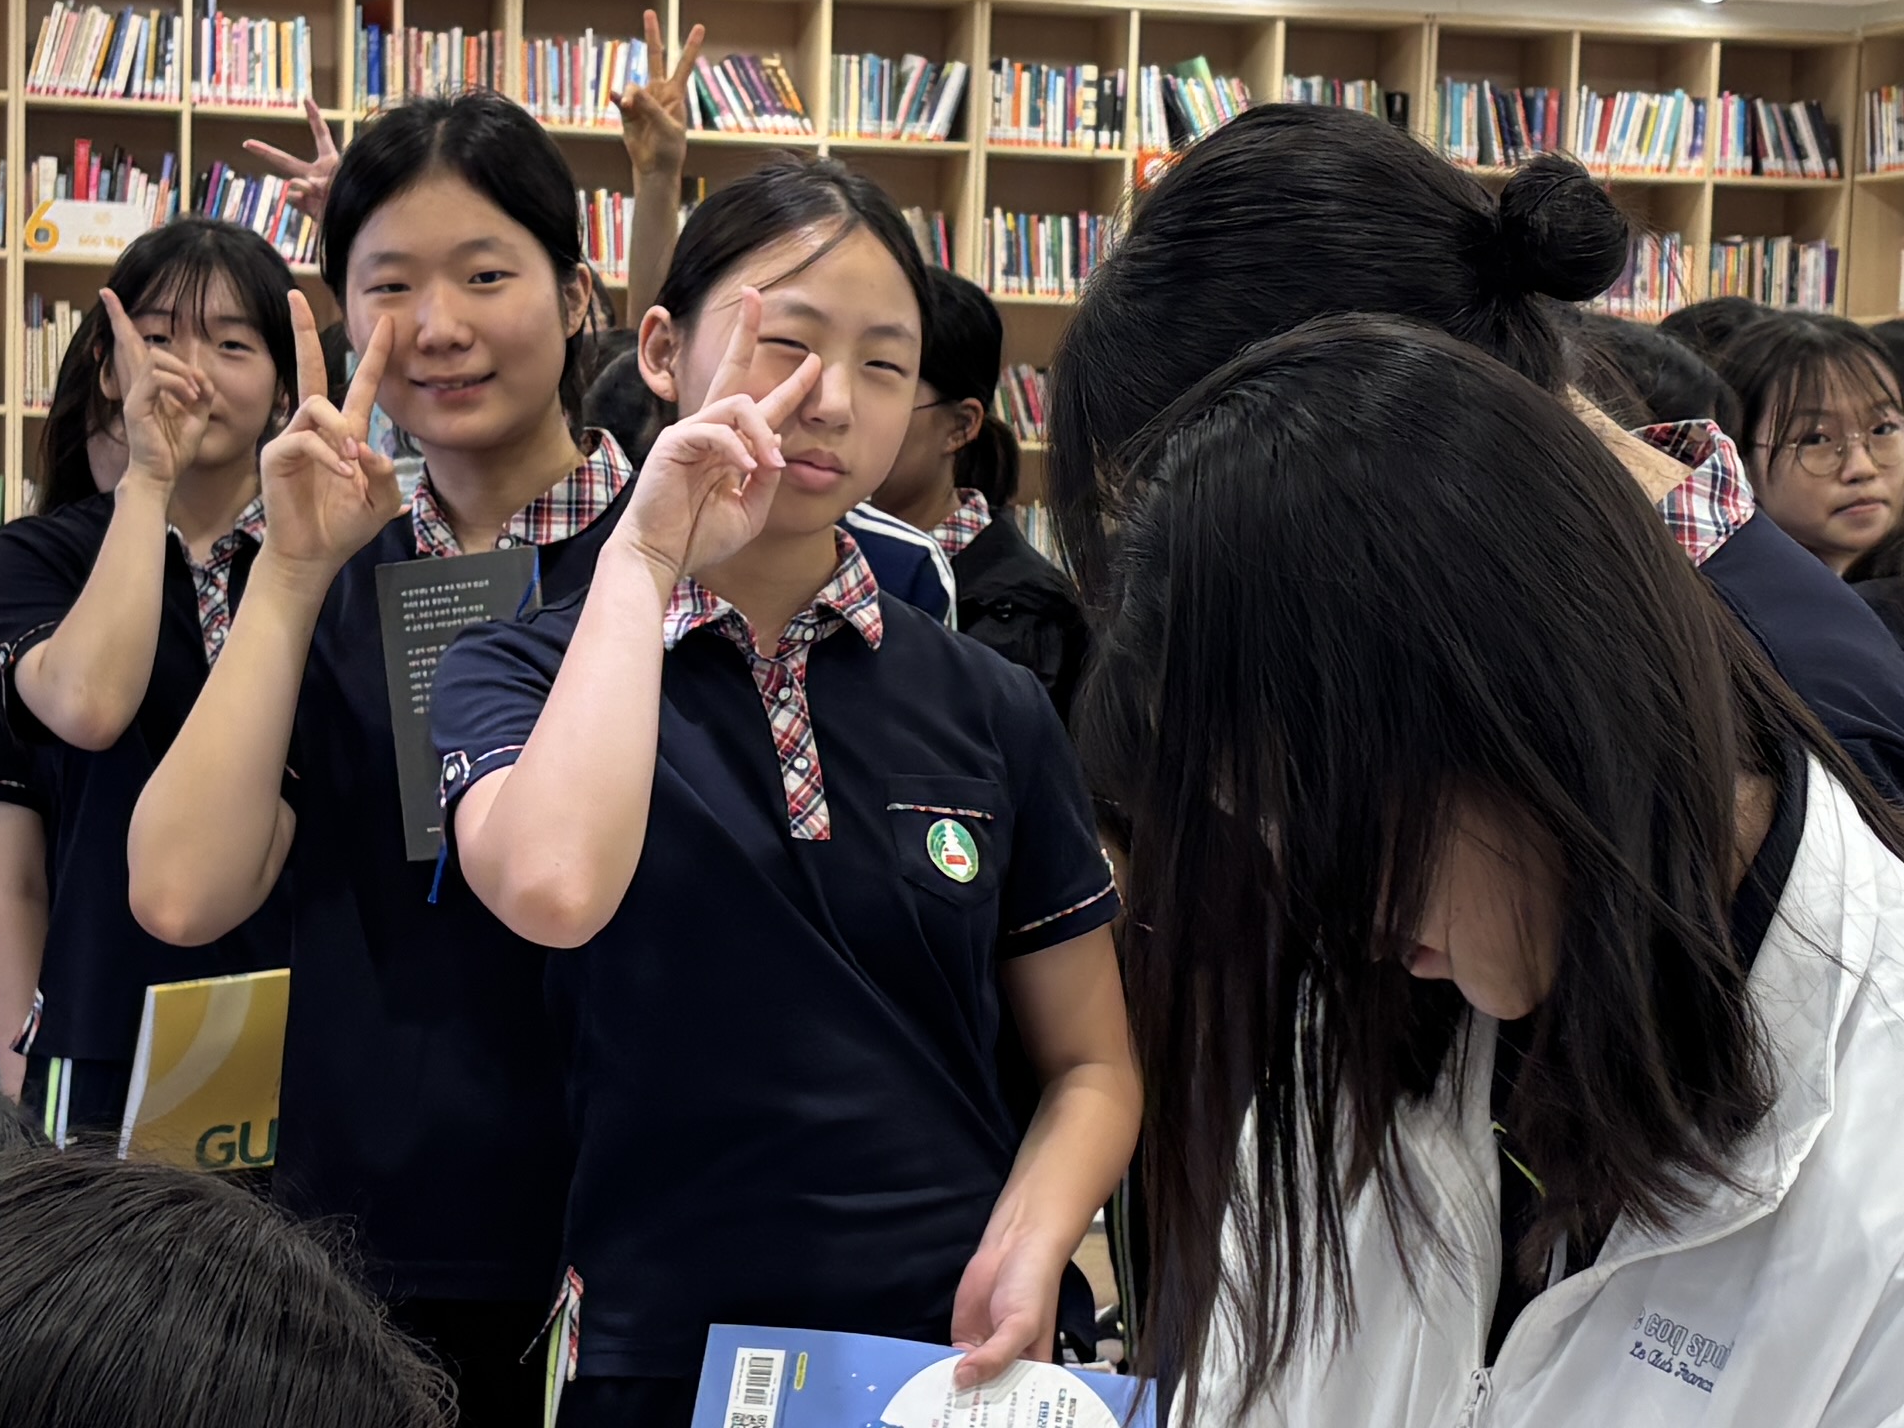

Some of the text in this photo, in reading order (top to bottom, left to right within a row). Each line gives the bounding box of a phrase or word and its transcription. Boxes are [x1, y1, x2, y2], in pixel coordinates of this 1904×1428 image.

[26, 200, 59, 251] 6
[1645, 1313, 1689, 1356] coq
[1648, 1349, 1672, 1373] Club
